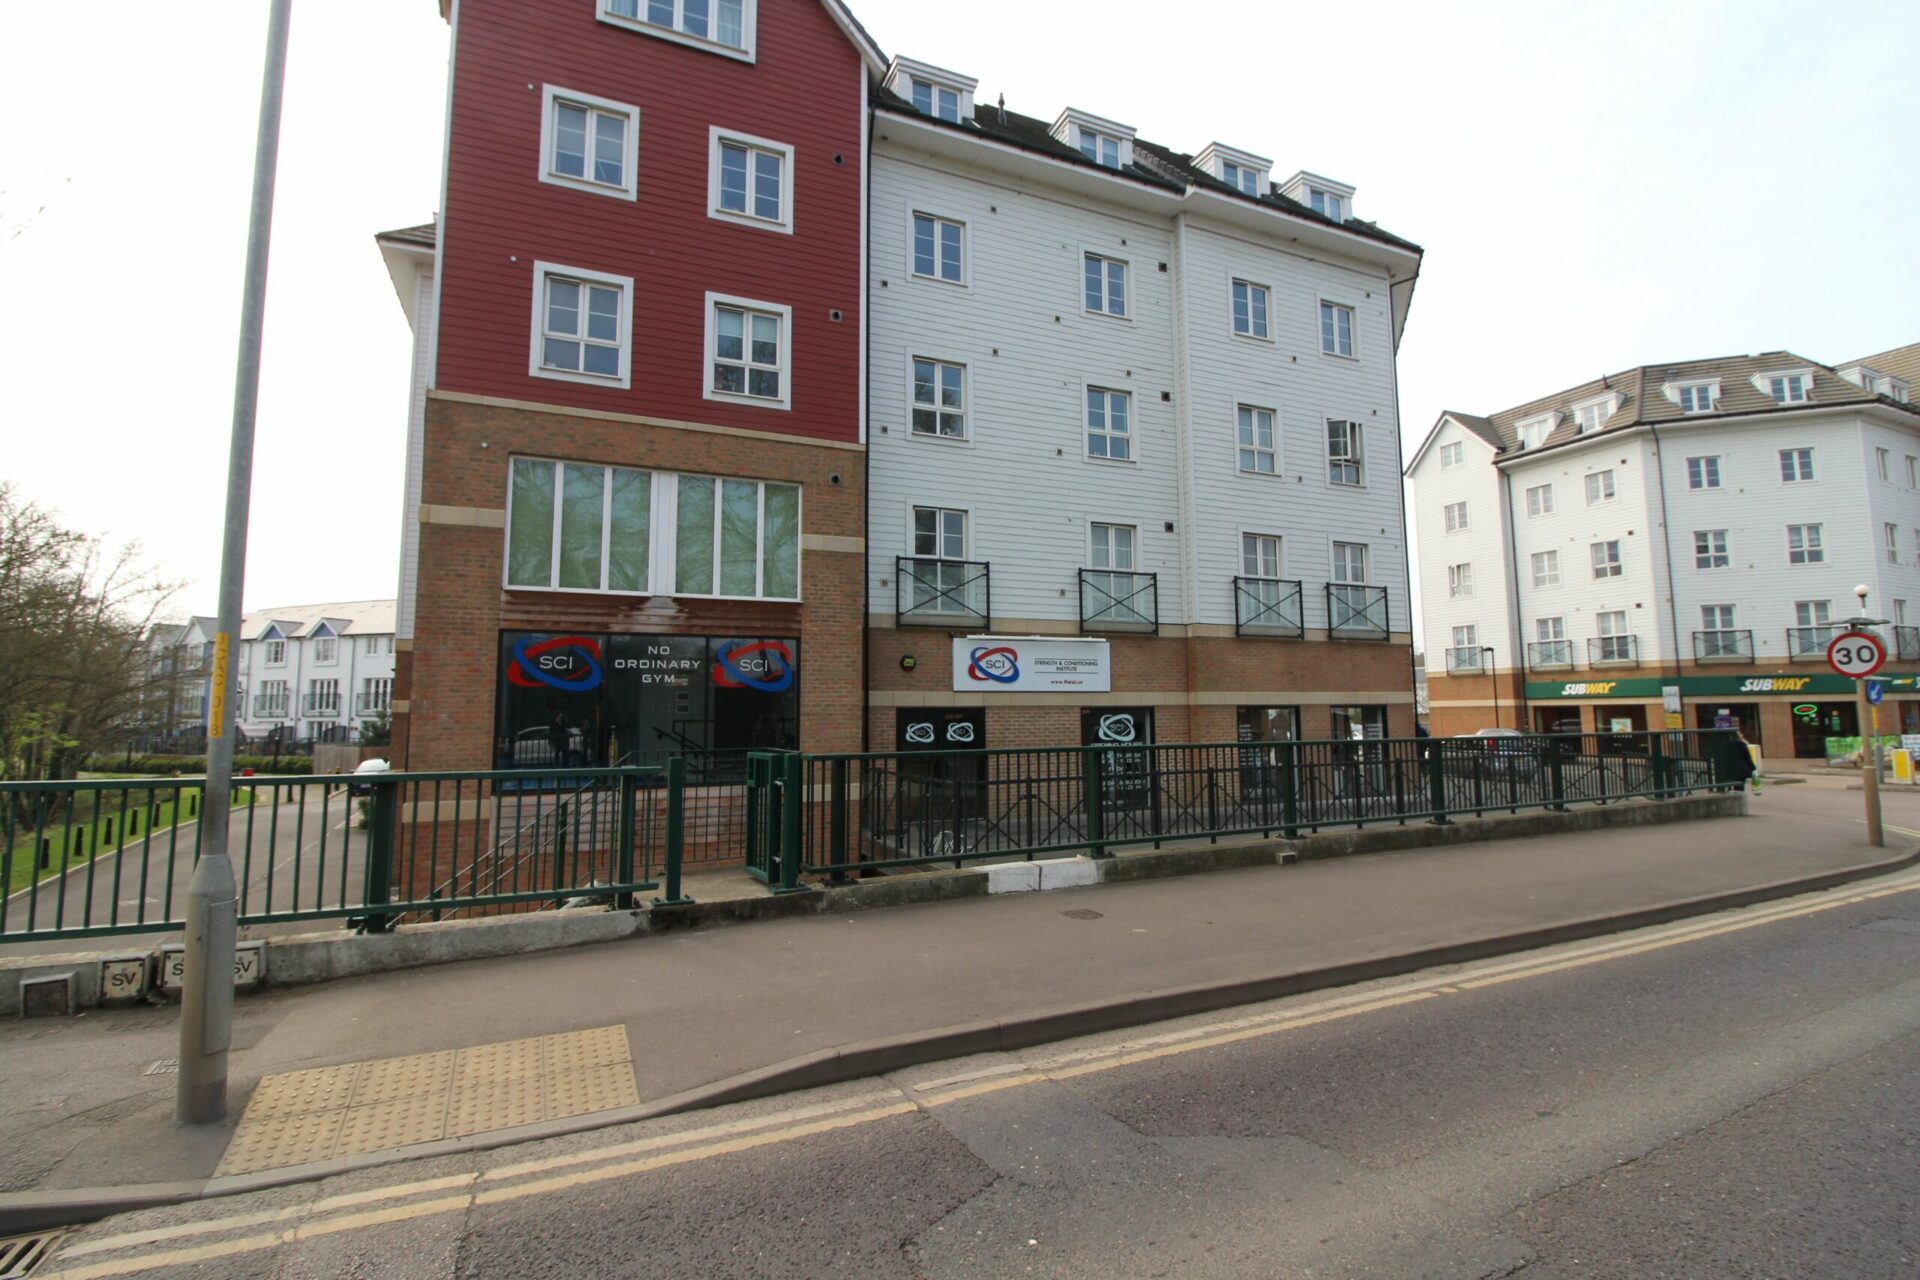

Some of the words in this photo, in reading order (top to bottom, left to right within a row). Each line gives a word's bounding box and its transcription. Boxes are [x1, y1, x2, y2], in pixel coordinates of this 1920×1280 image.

[648, 645, 671, 655] NO
[1835, 645, 1875, 665] 30
[539, 656, 573, 669] SCI
[615, 659, 701, 670] ORDINARY
[739, 659, 768, 671] SCI
[985, 660, 1005, 670] SCI
[642, 674, 675, 685] GYM
[1740, 676, 1811, 692] SUBWAY
[1561, 682, 1616, 696] SUBWAY
[1110, 724, 1124, 732] SCI
[172, 962, 184, 976] S
[112, 971, 136, 987] SV
